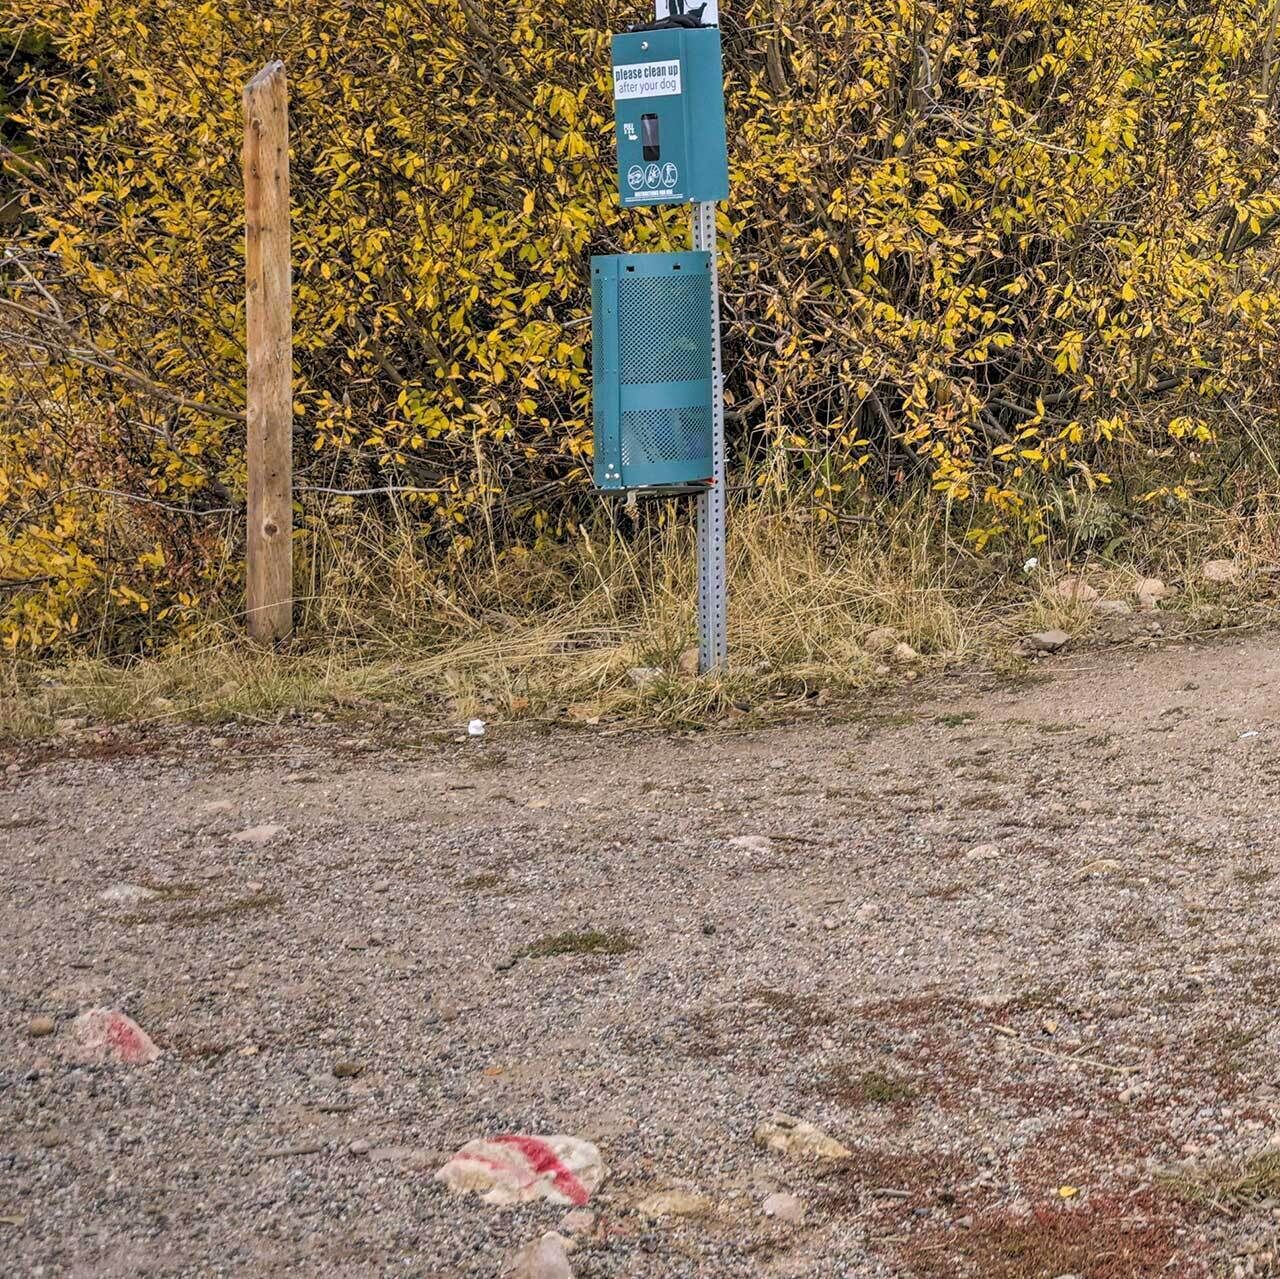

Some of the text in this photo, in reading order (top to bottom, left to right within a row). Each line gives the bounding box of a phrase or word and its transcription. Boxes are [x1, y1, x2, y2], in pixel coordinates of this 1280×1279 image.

[616, 64, 678, 82] please clean up
[619, 78, 676, 94] after your dog
